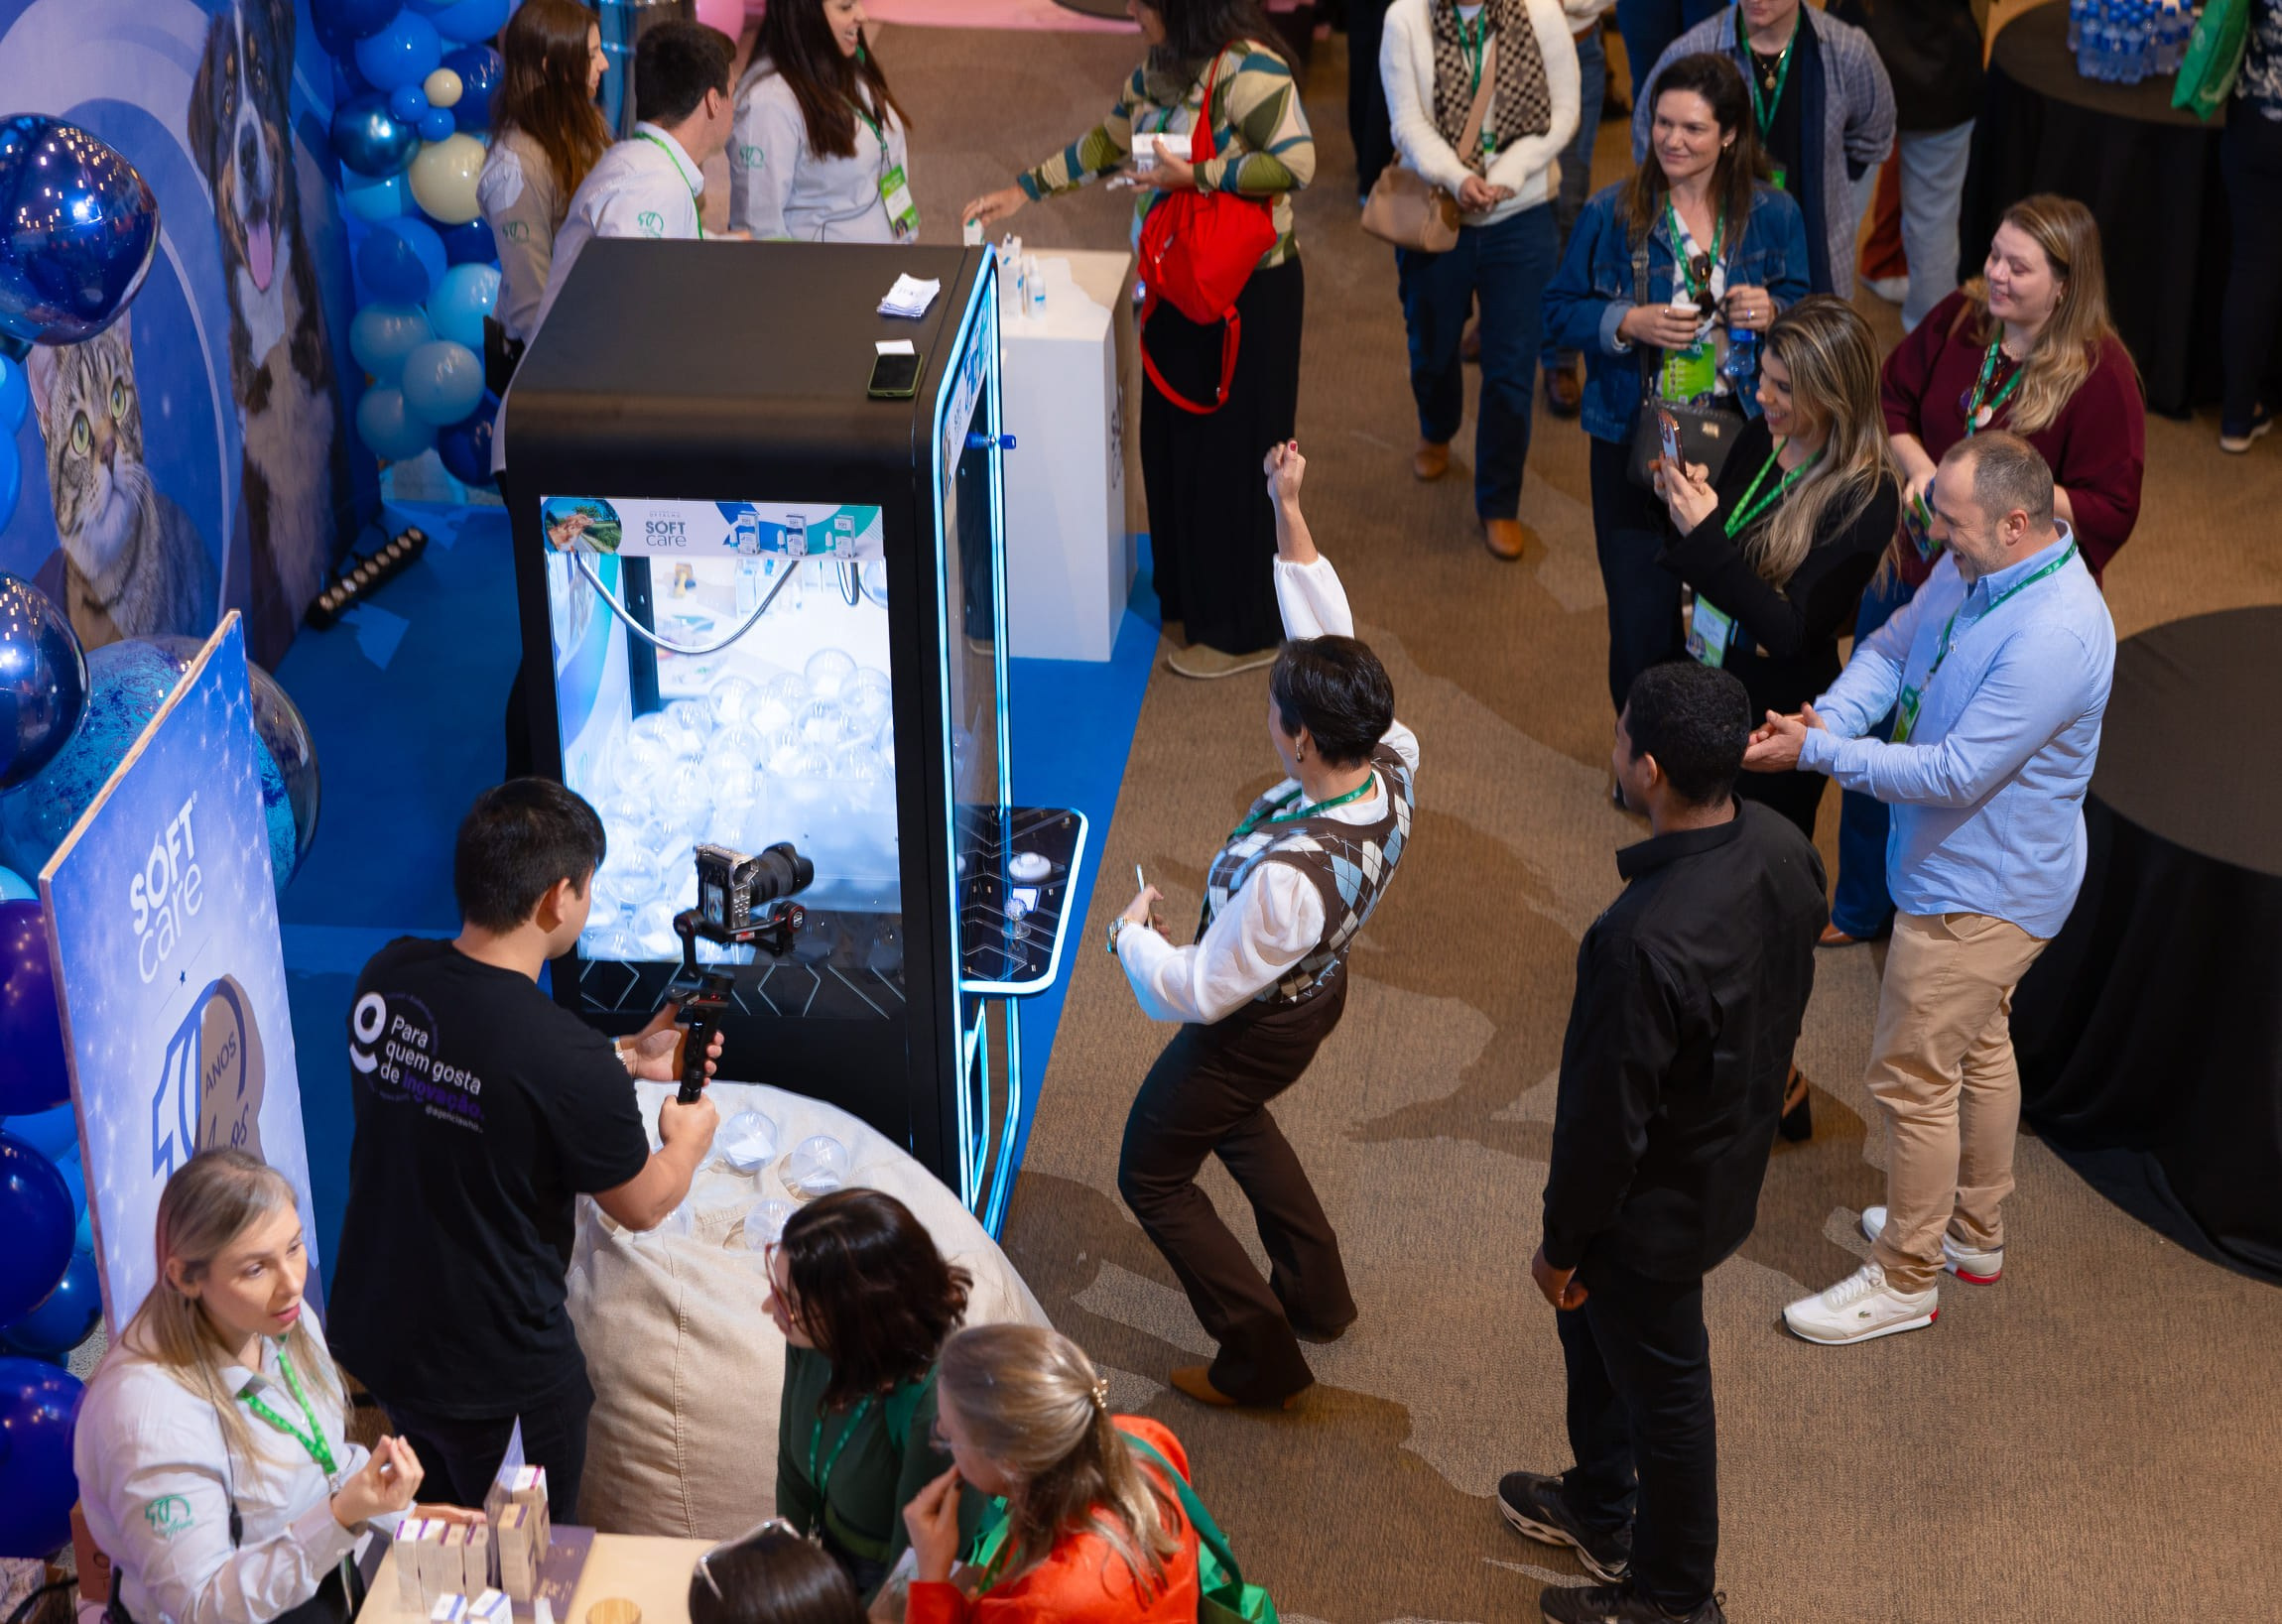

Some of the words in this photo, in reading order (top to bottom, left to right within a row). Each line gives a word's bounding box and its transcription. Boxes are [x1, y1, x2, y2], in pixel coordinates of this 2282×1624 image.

[645, 520, 686, 535] SOFT
[646, 535, 687, 547] care
[130, 797, 195, 936] SOFT
[139, 863, 203, 983] care
[391, 1014, 429, 1050] Para
[205, 1029, 237, 1101] ANOS
[380, 1062, 400, 1084] de
[385, 1040, 431, 1073] quem
[432, 1061, 481, 1095] gosta
